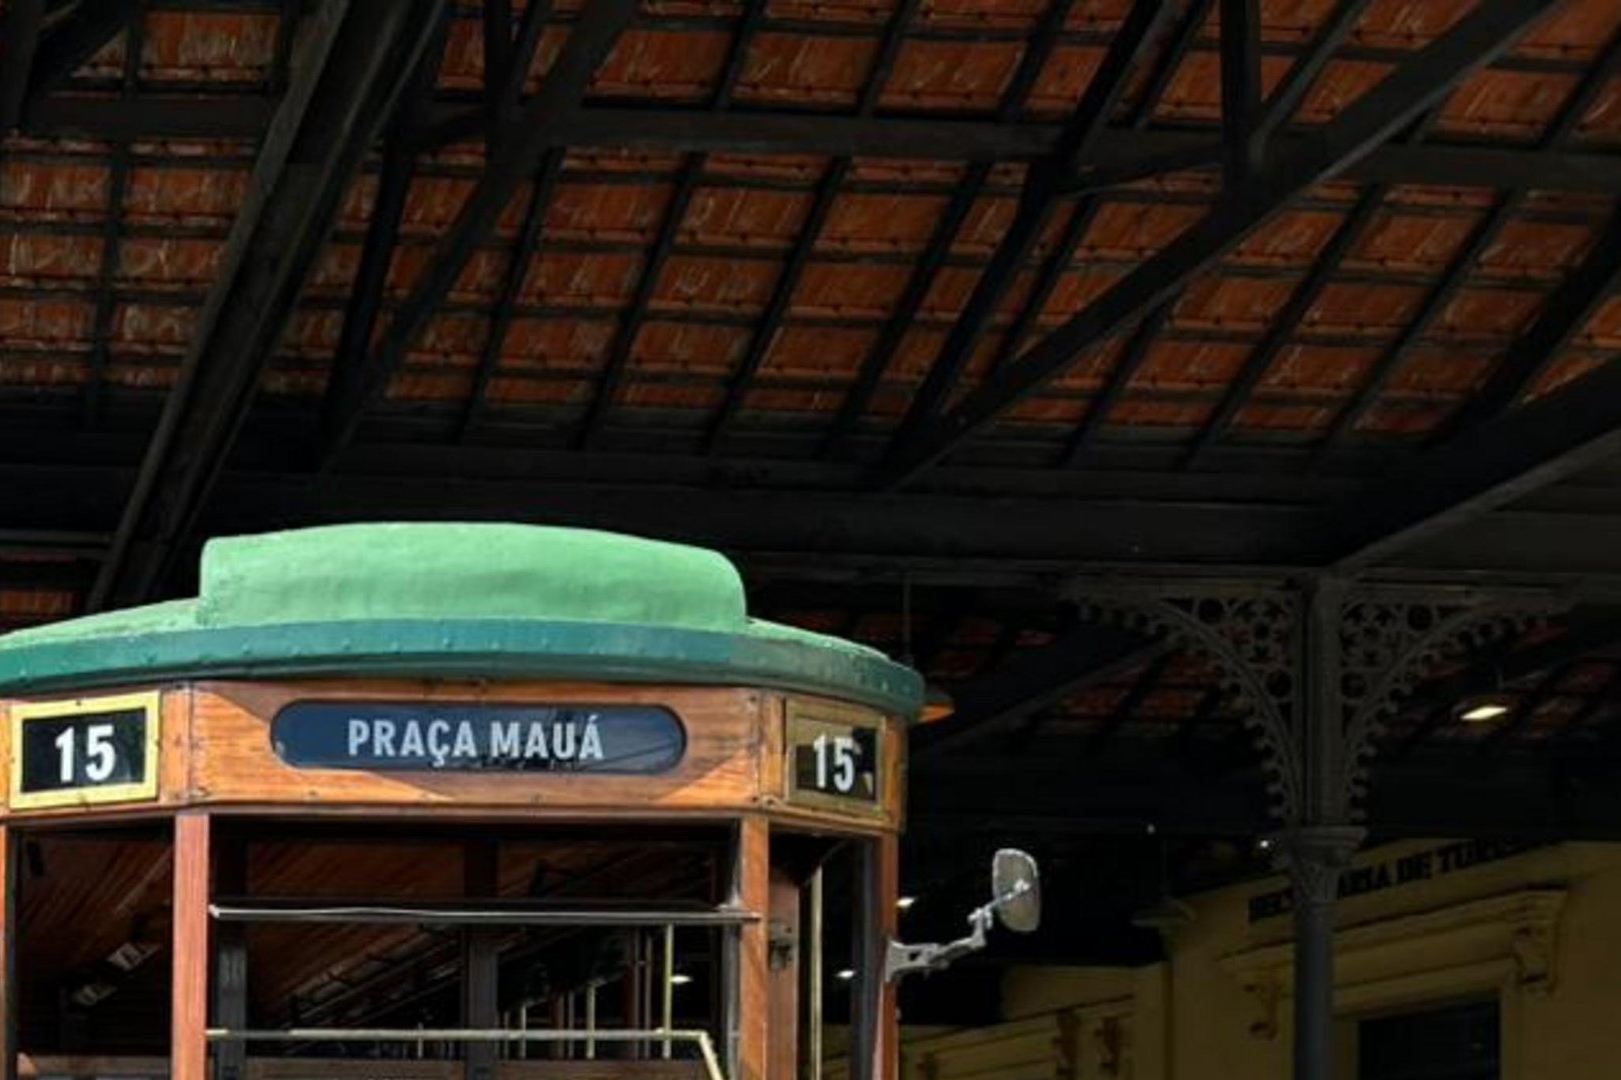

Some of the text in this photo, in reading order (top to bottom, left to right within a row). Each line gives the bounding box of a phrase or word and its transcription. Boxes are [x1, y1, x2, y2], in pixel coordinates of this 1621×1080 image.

[55, 724, 115, 783] 15
[348, 714, 604, 767] PRAÇA MAUÁ
[813, 734, 854, 792] 15
